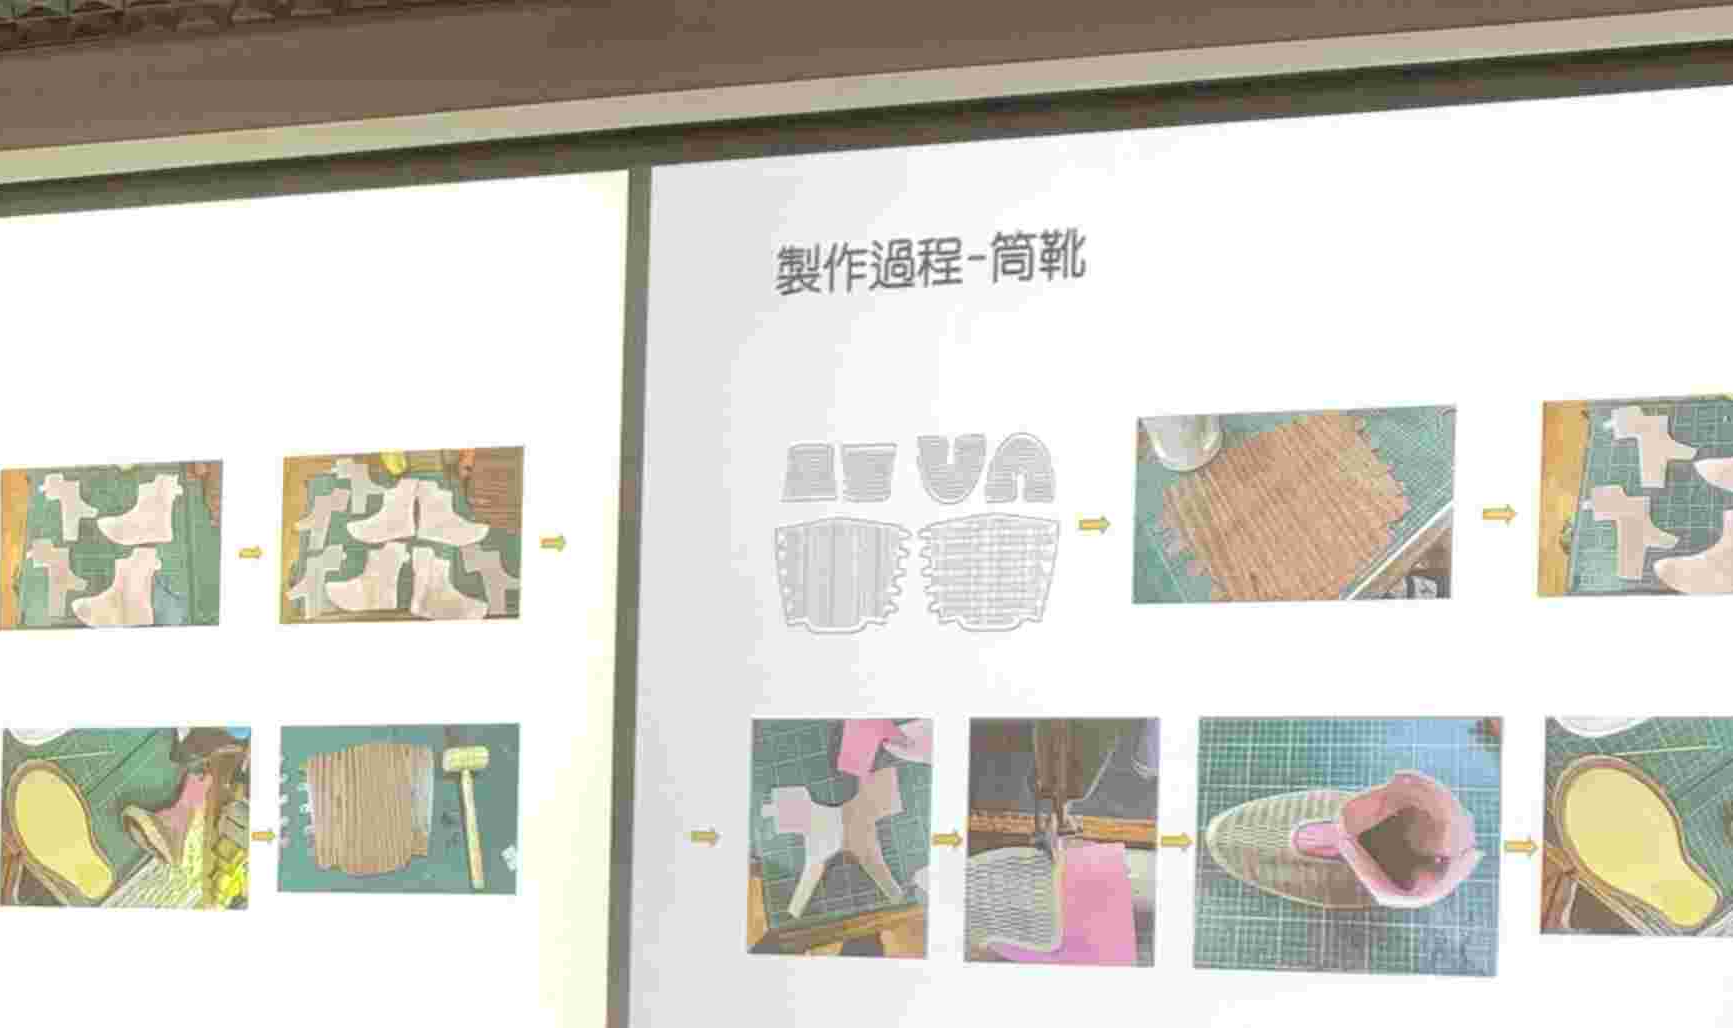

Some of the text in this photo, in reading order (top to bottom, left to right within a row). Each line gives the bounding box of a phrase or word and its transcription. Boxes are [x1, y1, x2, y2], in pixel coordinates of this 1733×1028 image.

[775, 228, 1086, 295] 製作過程-筒靴
